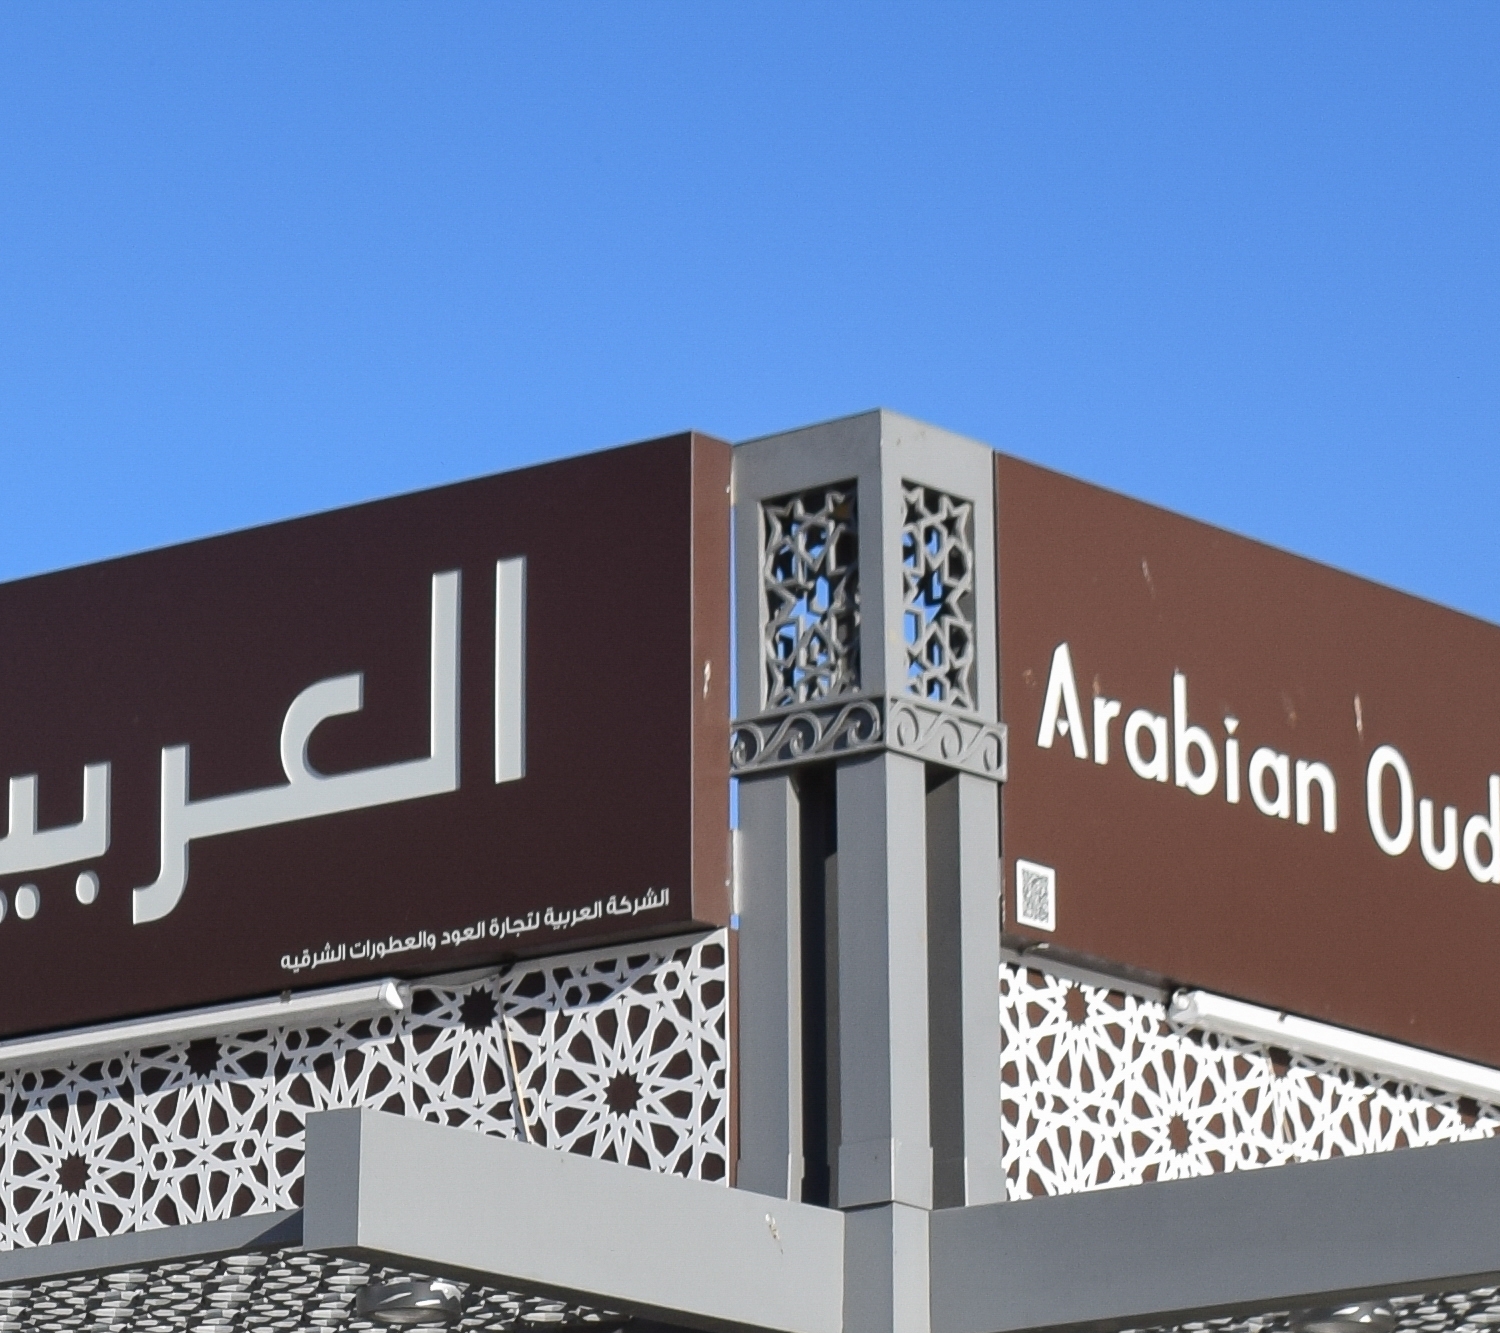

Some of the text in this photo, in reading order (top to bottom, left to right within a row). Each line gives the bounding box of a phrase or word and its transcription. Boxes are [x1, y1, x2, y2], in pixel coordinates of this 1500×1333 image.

[1037, 642, 1337, 834] Arabian
[543, 900, 603, 931] العربية
[605, 887, 670, 916] الشركة
[440, 920, 486, 947] العود
[488, 911, 541, 940] لتجارة
[349, 930, 437, 961] والعطورات
